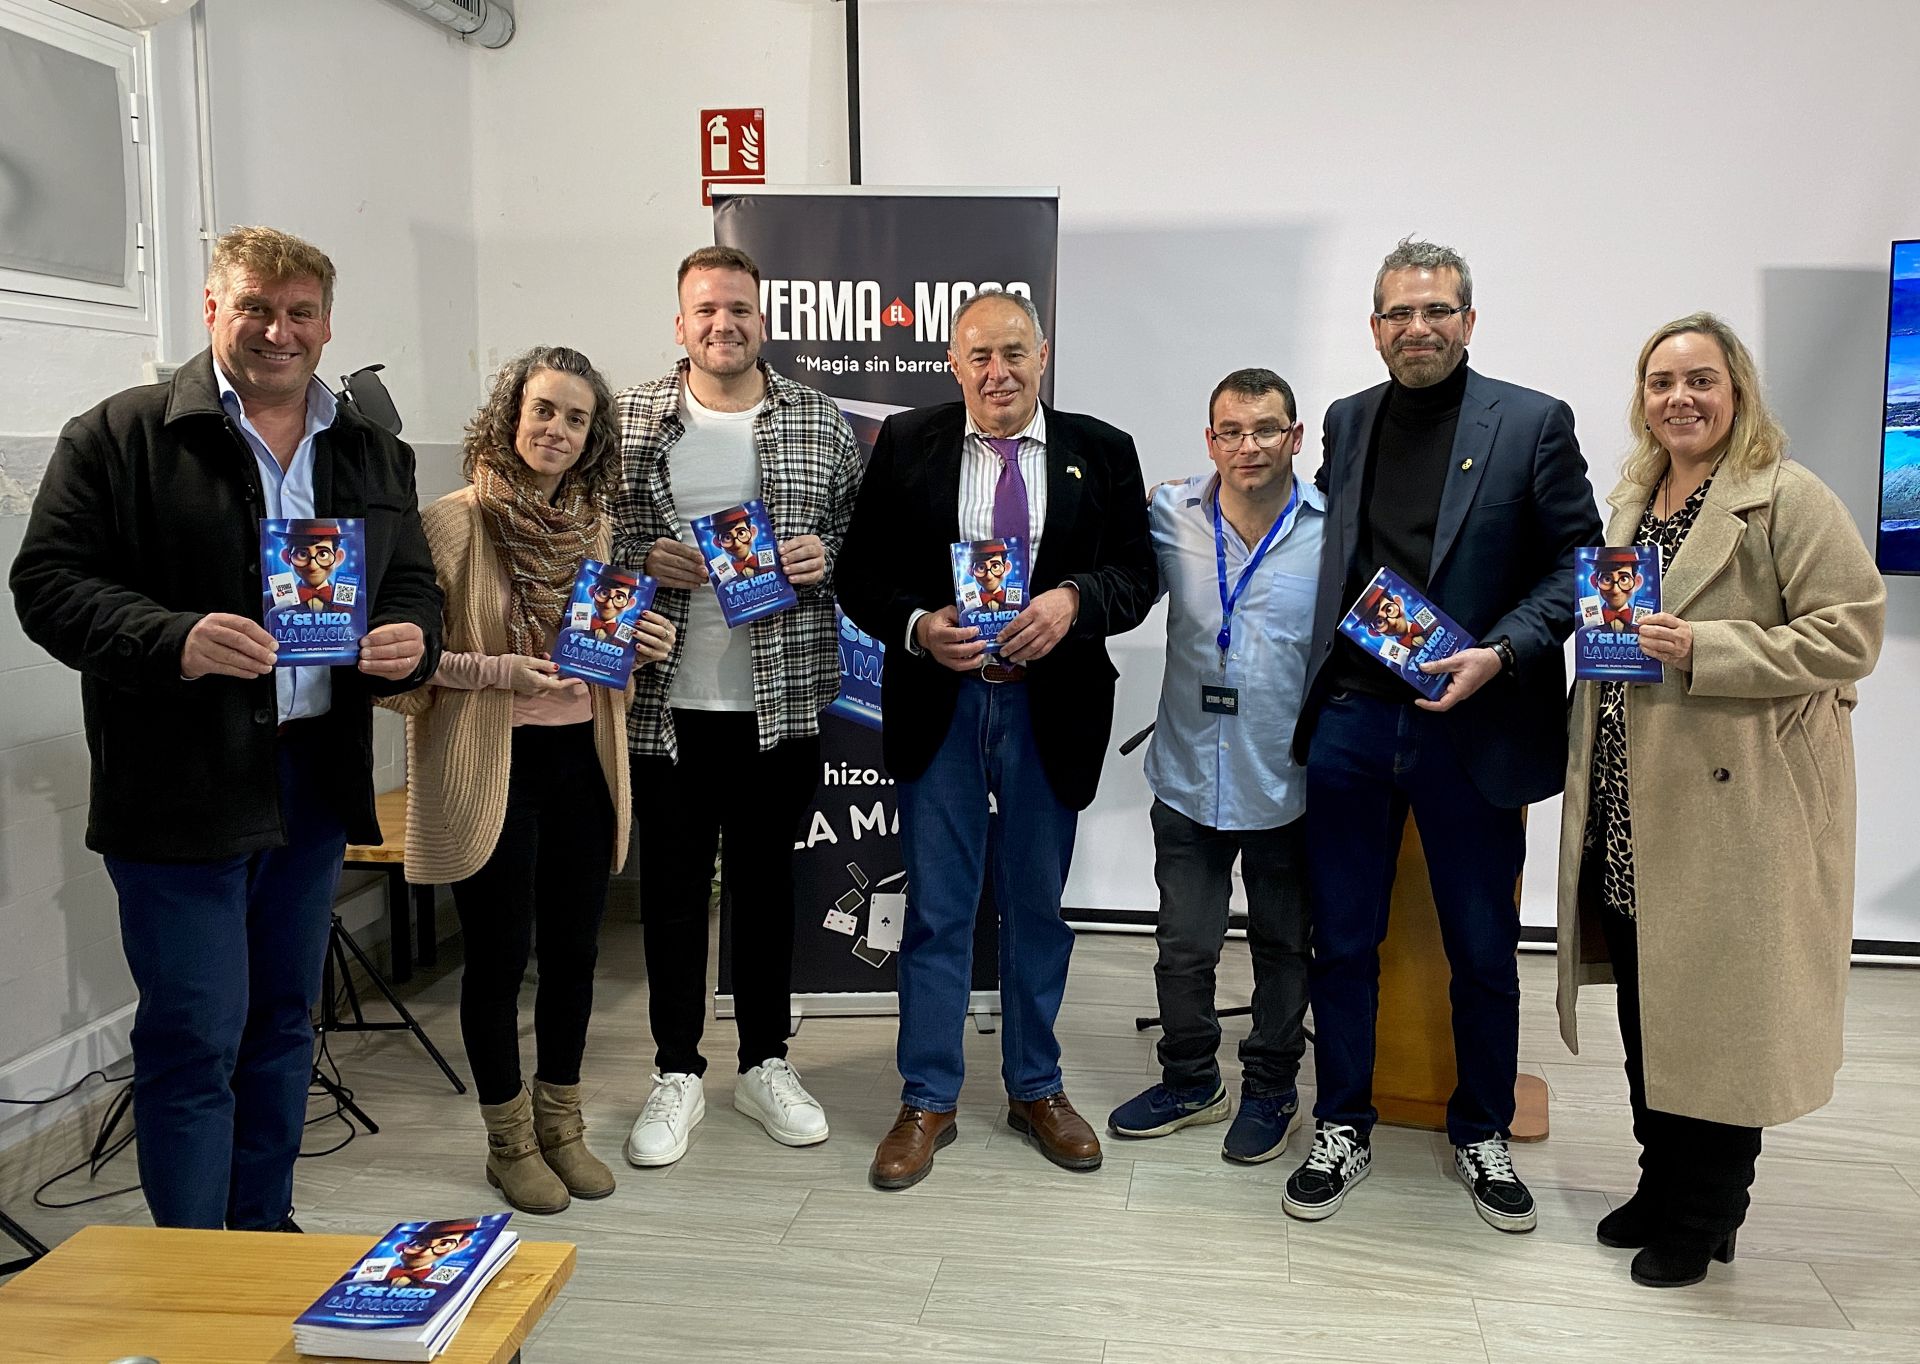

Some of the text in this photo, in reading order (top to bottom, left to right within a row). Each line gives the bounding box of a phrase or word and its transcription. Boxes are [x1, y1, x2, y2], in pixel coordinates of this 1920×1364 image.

[890, 305, 905, 322] EL
[864, 355, 889, 372] sin
[725, 571, 777, 595] Y SE HIZO
[727, 595, 745, 609] LA
[278, 612, 351, 626] Y SE HIZO
[967, 613, 977, 624] Y
[978, 612, 992, 623] SE
[275, 627, 356, 643] LA MAGIA
[1586, 632, 1596, 644] Y
[1598, 633, 1615, 645] SE
[561, 644, 579, 659] LA
[569, 633, 624, 657] Y SE HIZO
[1408, 626, 1446, 672] Y SE HIZO
[1583, 646, 1650, 661] LA MAGI
[345, 1285, 437, 1299] Y SE HIZO
[324, 1296, 356, 1309] LA
